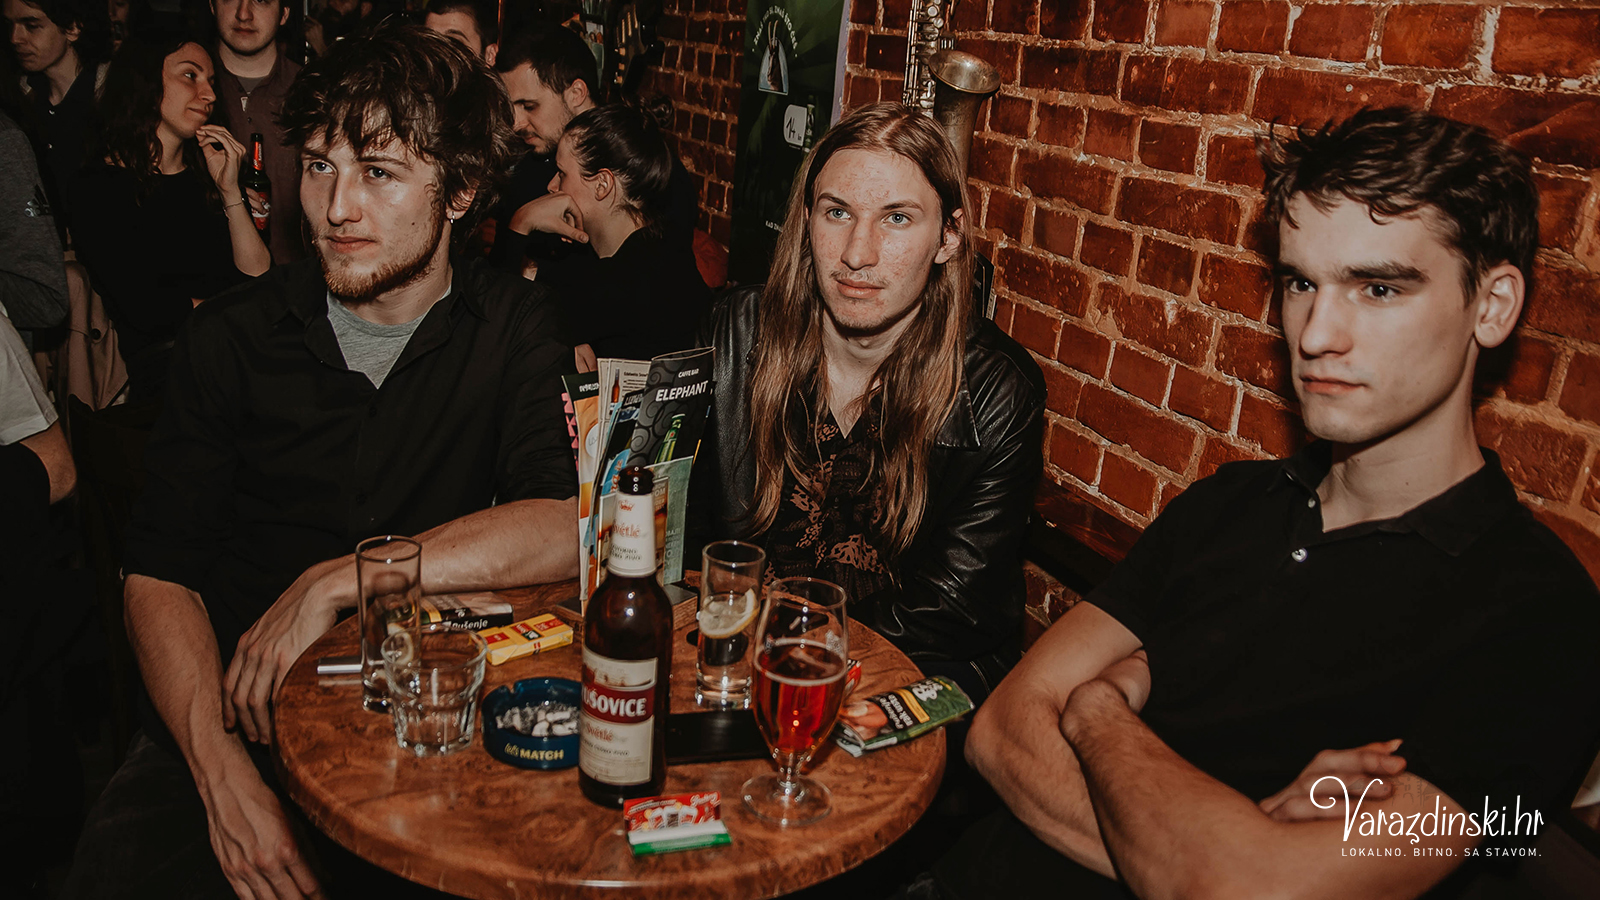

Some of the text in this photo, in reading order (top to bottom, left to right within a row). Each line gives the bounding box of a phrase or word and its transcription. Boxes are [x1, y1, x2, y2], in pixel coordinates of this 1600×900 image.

[678, 368, 700, 378] CAFFE BAR
[656, 380, 709, 402] ELEPHANT
[583, 686, 647, 717] UŠOVICE
[520, 748, 564, 761] MATCH
